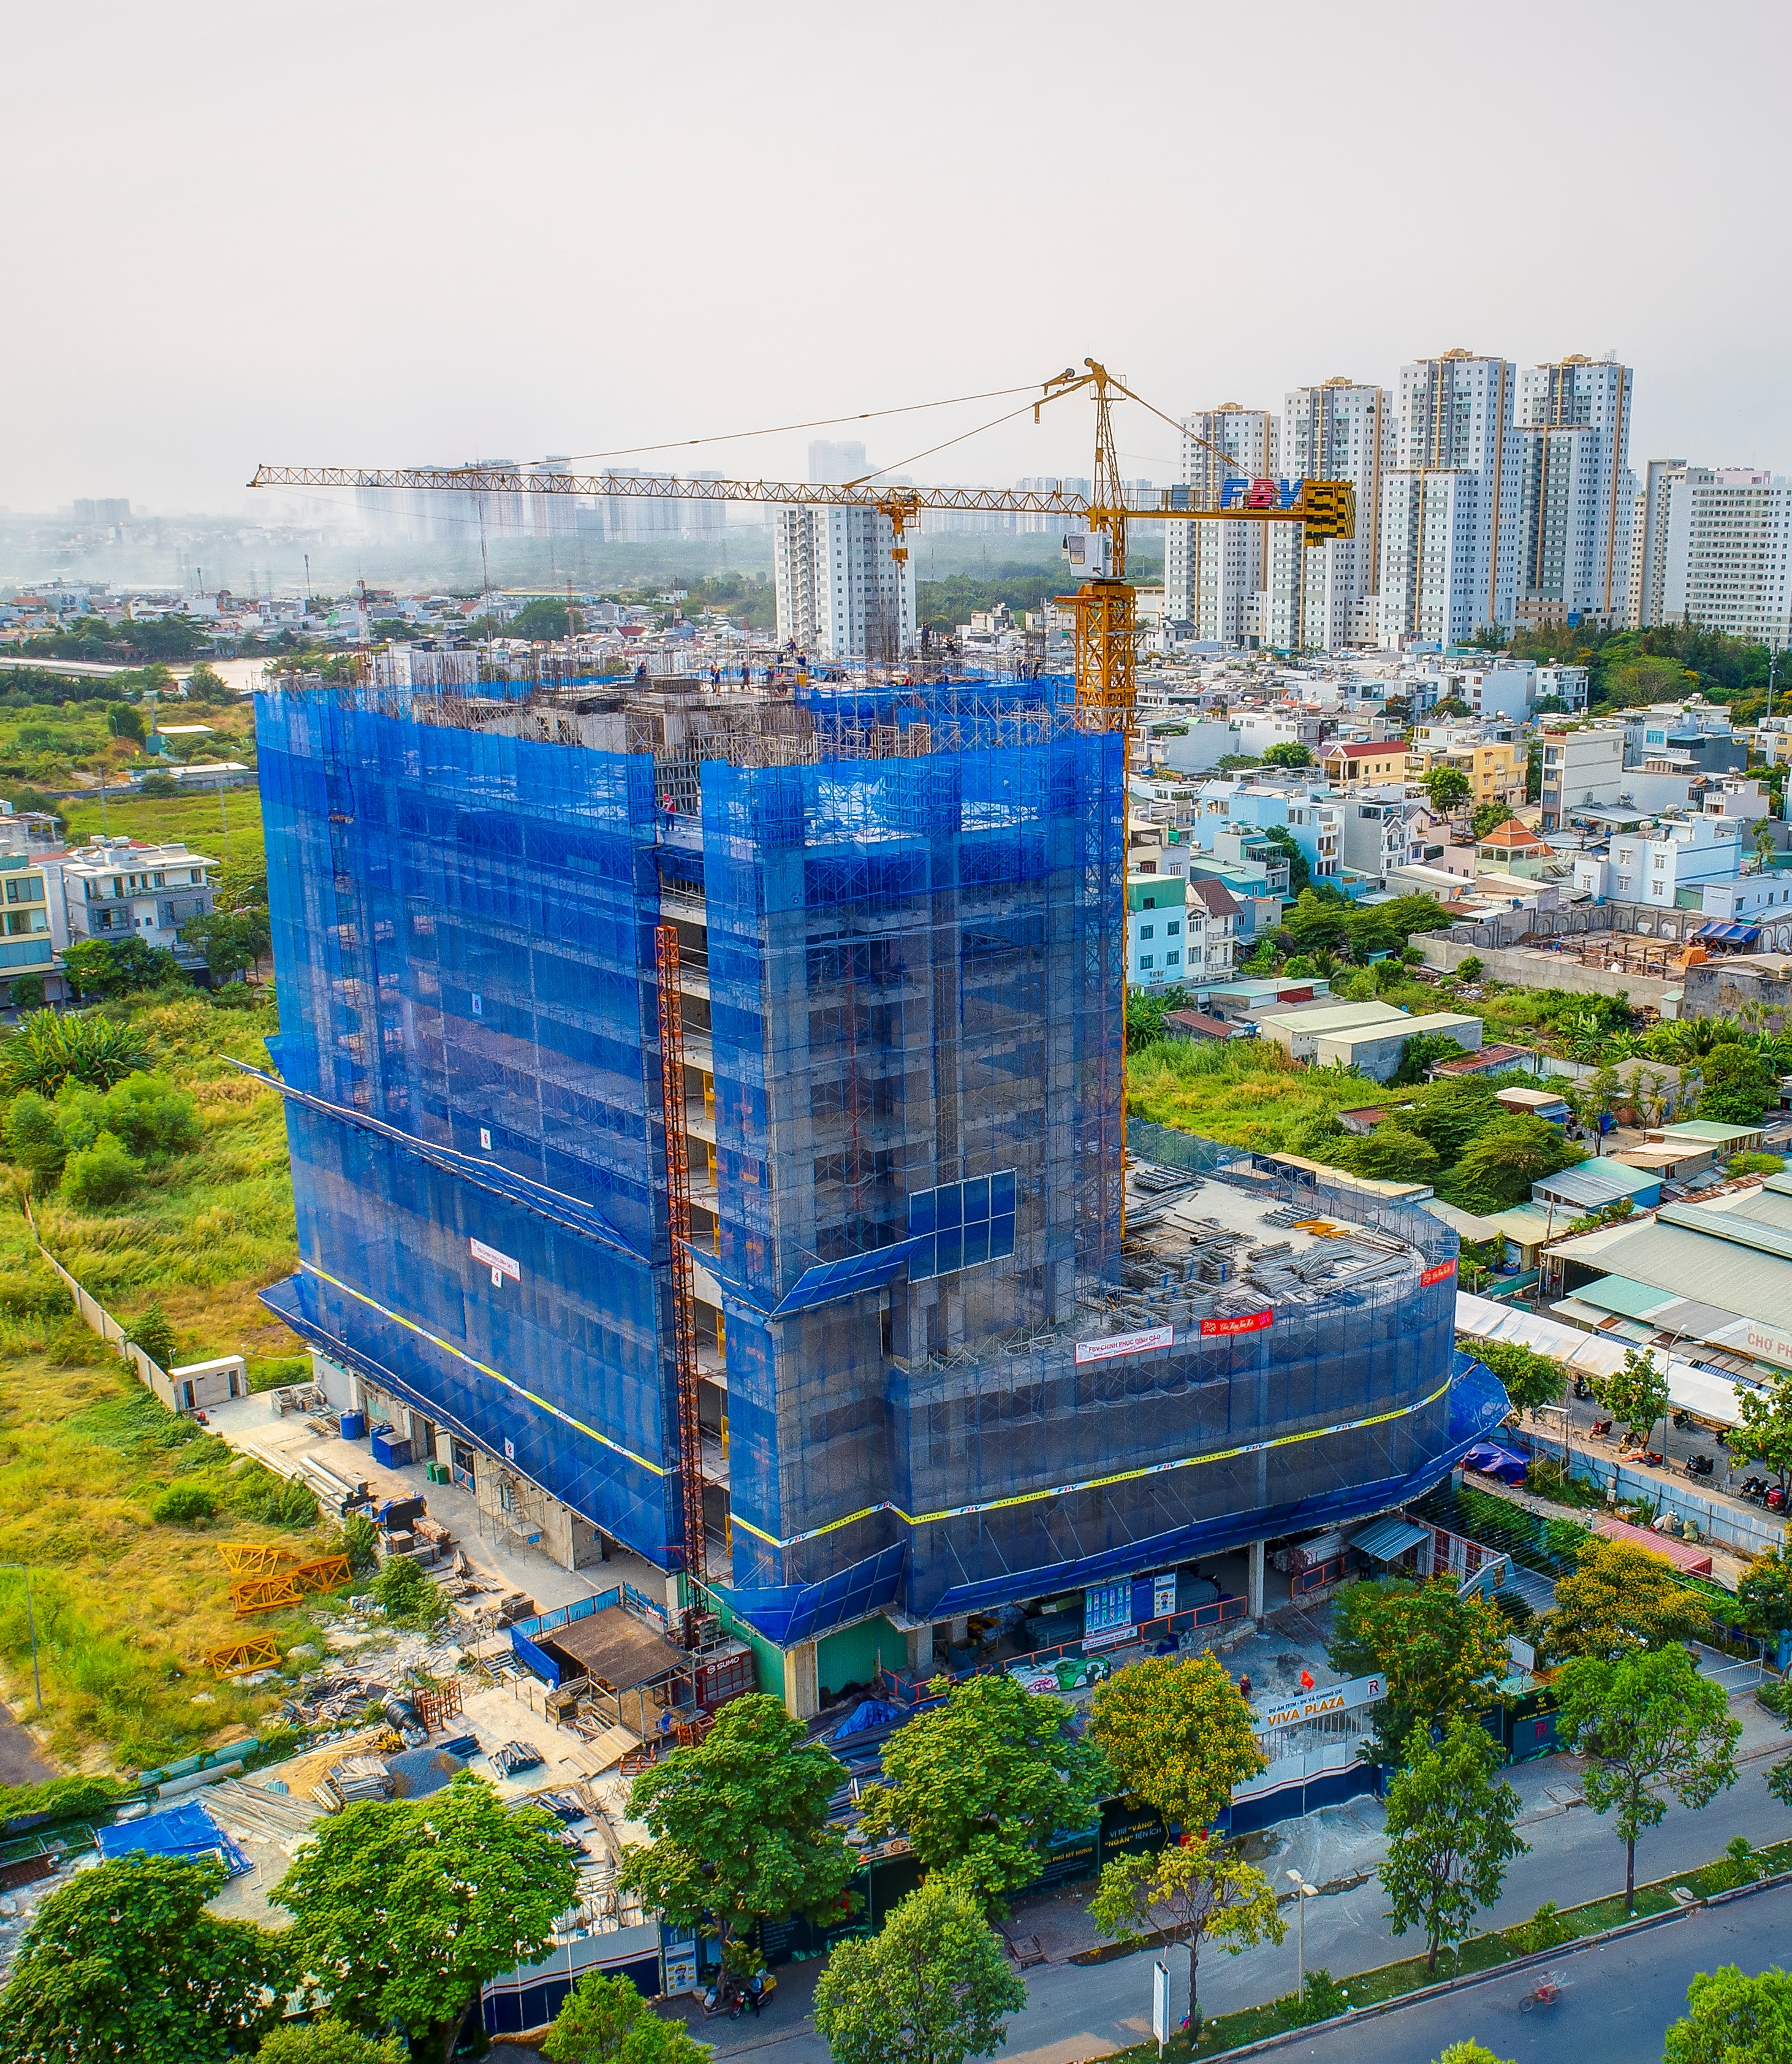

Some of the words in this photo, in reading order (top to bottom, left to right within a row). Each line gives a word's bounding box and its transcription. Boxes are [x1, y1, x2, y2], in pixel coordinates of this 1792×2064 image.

[1220, 479, 1305, 508] FBV
[702, 1197, 707, 1208] 6
[1747, 1332, 1774, 1354] CHỢ
[1156, 1461, 1176, 1470] FBV
[1057, 1485, 1077, 1493] FBV
[997, 1497, 1023, 1506] SAFETY
[960, 1505, 981, 1514] FBV
[788, 1533, 808, 1544] FBV
[716, 1656, 740, 1670] SUMO
[1368, 1680, 1379, 1694] R
[1316, 1691, 1334, 1700] CHUNG
[1267, 1708, 1300, 1726] VIVA
[1304, 1695, 1345, 1716] PLAZA
